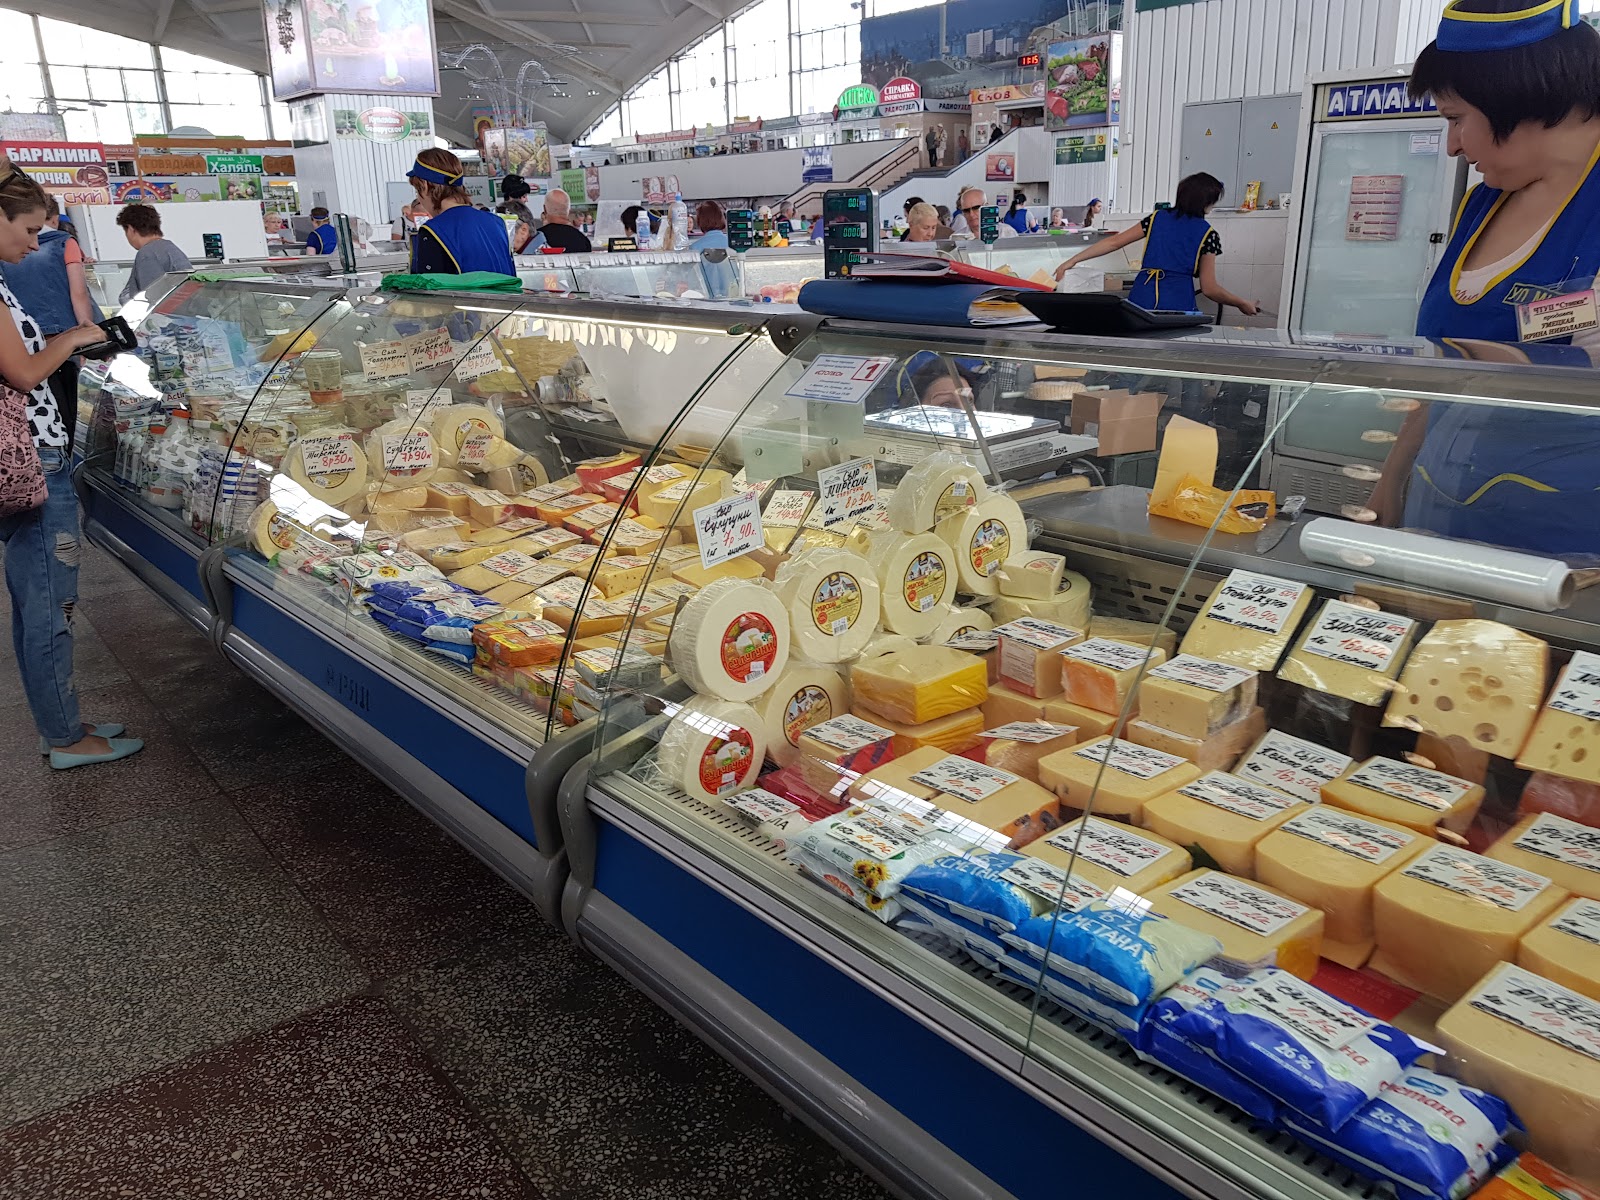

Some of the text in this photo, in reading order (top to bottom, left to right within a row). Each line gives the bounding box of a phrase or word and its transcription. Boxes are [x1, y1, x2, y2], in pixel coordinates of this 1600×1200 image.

[840, 87, 876, 107] АПТЕКА
[884, 83, 915, 95] СПРАВКА
[884, 92, 915, 101] INFORMATION
[1328, 86, 1437, 112] АТЛАН
[884, 103, 916, 113] РАДИОУЗЕЛ
[1098, 135, 1104, 144] 3
[6, 147, 103, 163] БАРАНИНА
[804, 154, 831, 167] ВИЗЫ
[210, 161, 261, 173] Халяль
[864, 363, 880, 379] 1
[727, 642, 775, 671] СУЛУГУНИ
[1292, 748, 1326, 767] СЫР
[1058, 911, 1144, 958] СМЕТАНА
[1273, 1040, 1316, 1071] 26 %
[1369, 1105, 1396, 1124] 26
